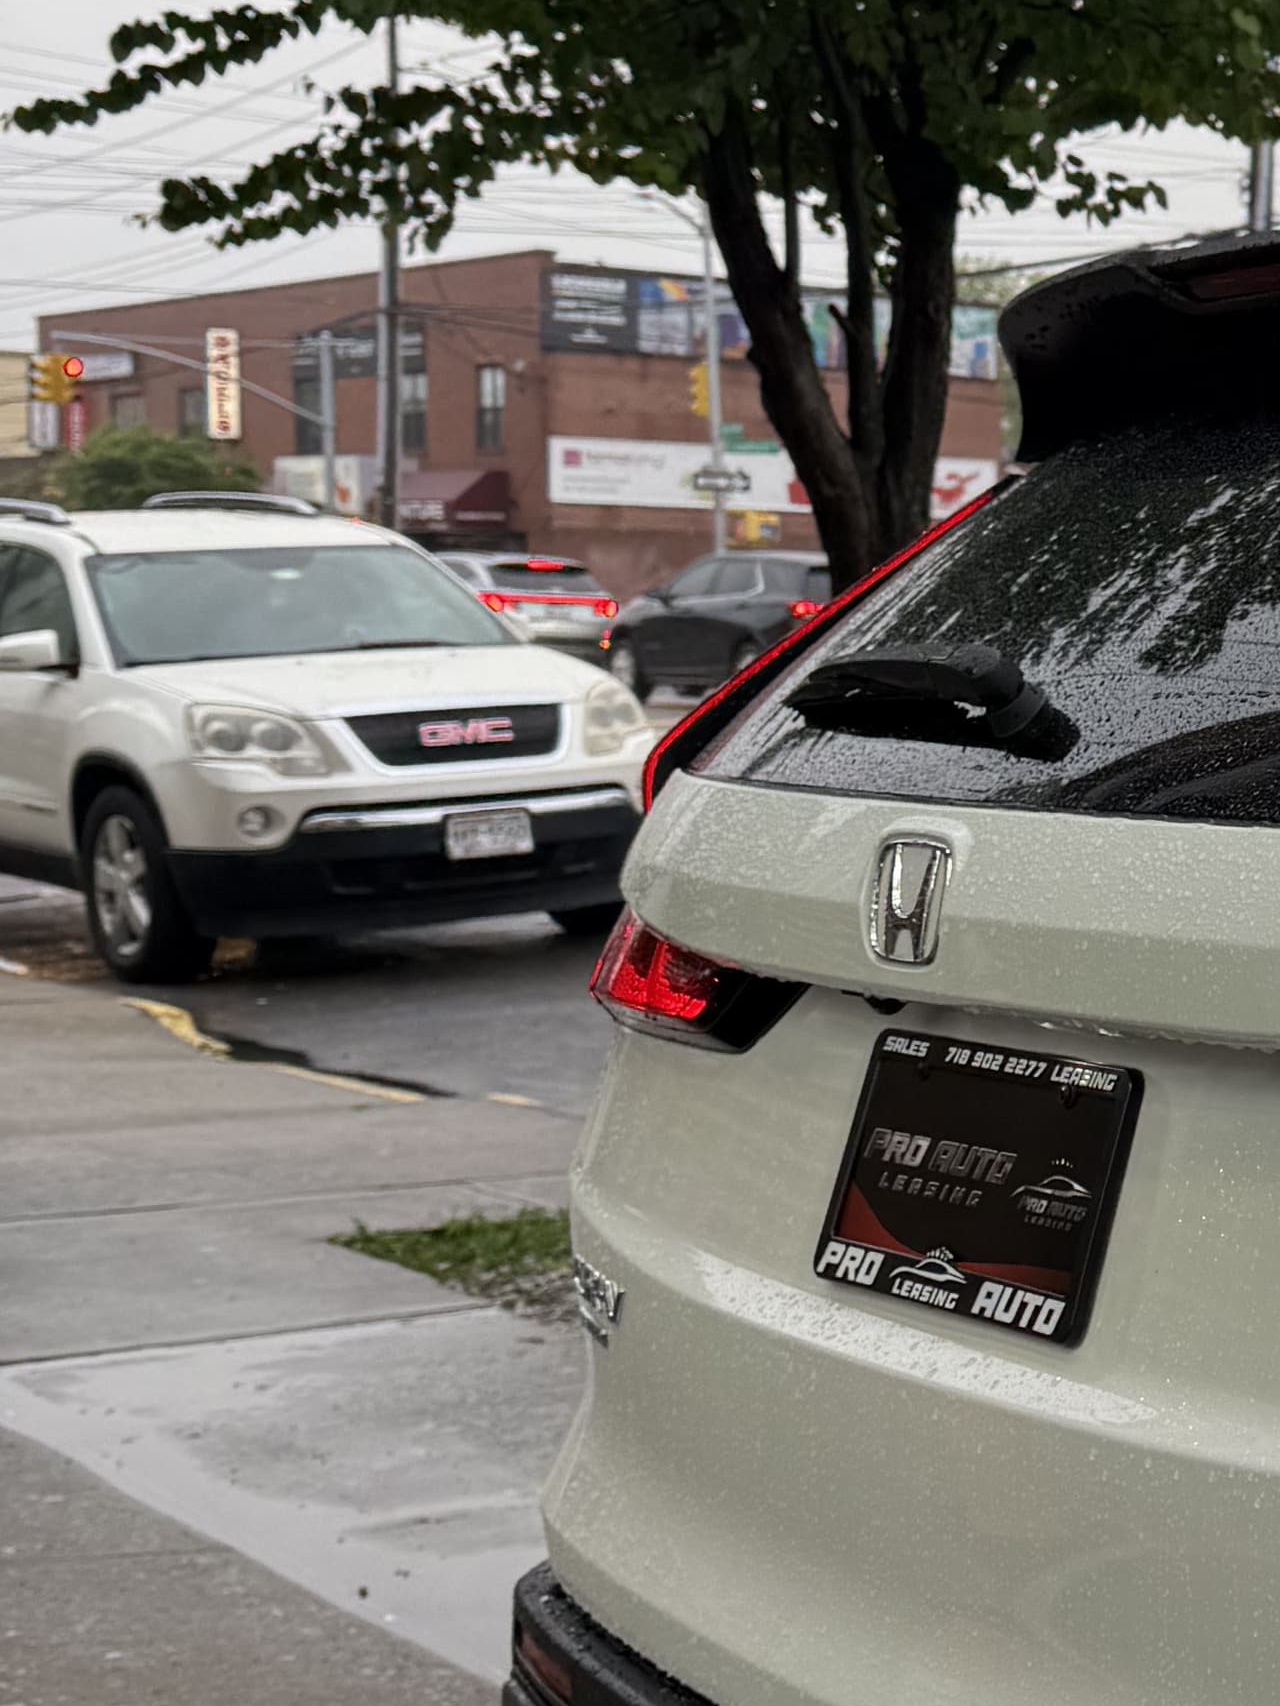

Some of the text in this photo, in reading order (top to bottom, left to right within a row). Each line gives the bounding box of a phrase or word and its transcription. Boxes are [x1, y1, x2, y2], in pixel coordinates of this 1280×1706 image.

[418, 717, 513, 747] GMC
[883, 1035, 1118, 1091] SALES 718 902 2277 LEASING
[864, 1127, 1018, 1185] PRO AUTO
[878, 1171, 983, 1207] LEASING
[817, 1241, 1066, 1336] PRO AUTO
[891, 1277, 959, 1310] LEASING
